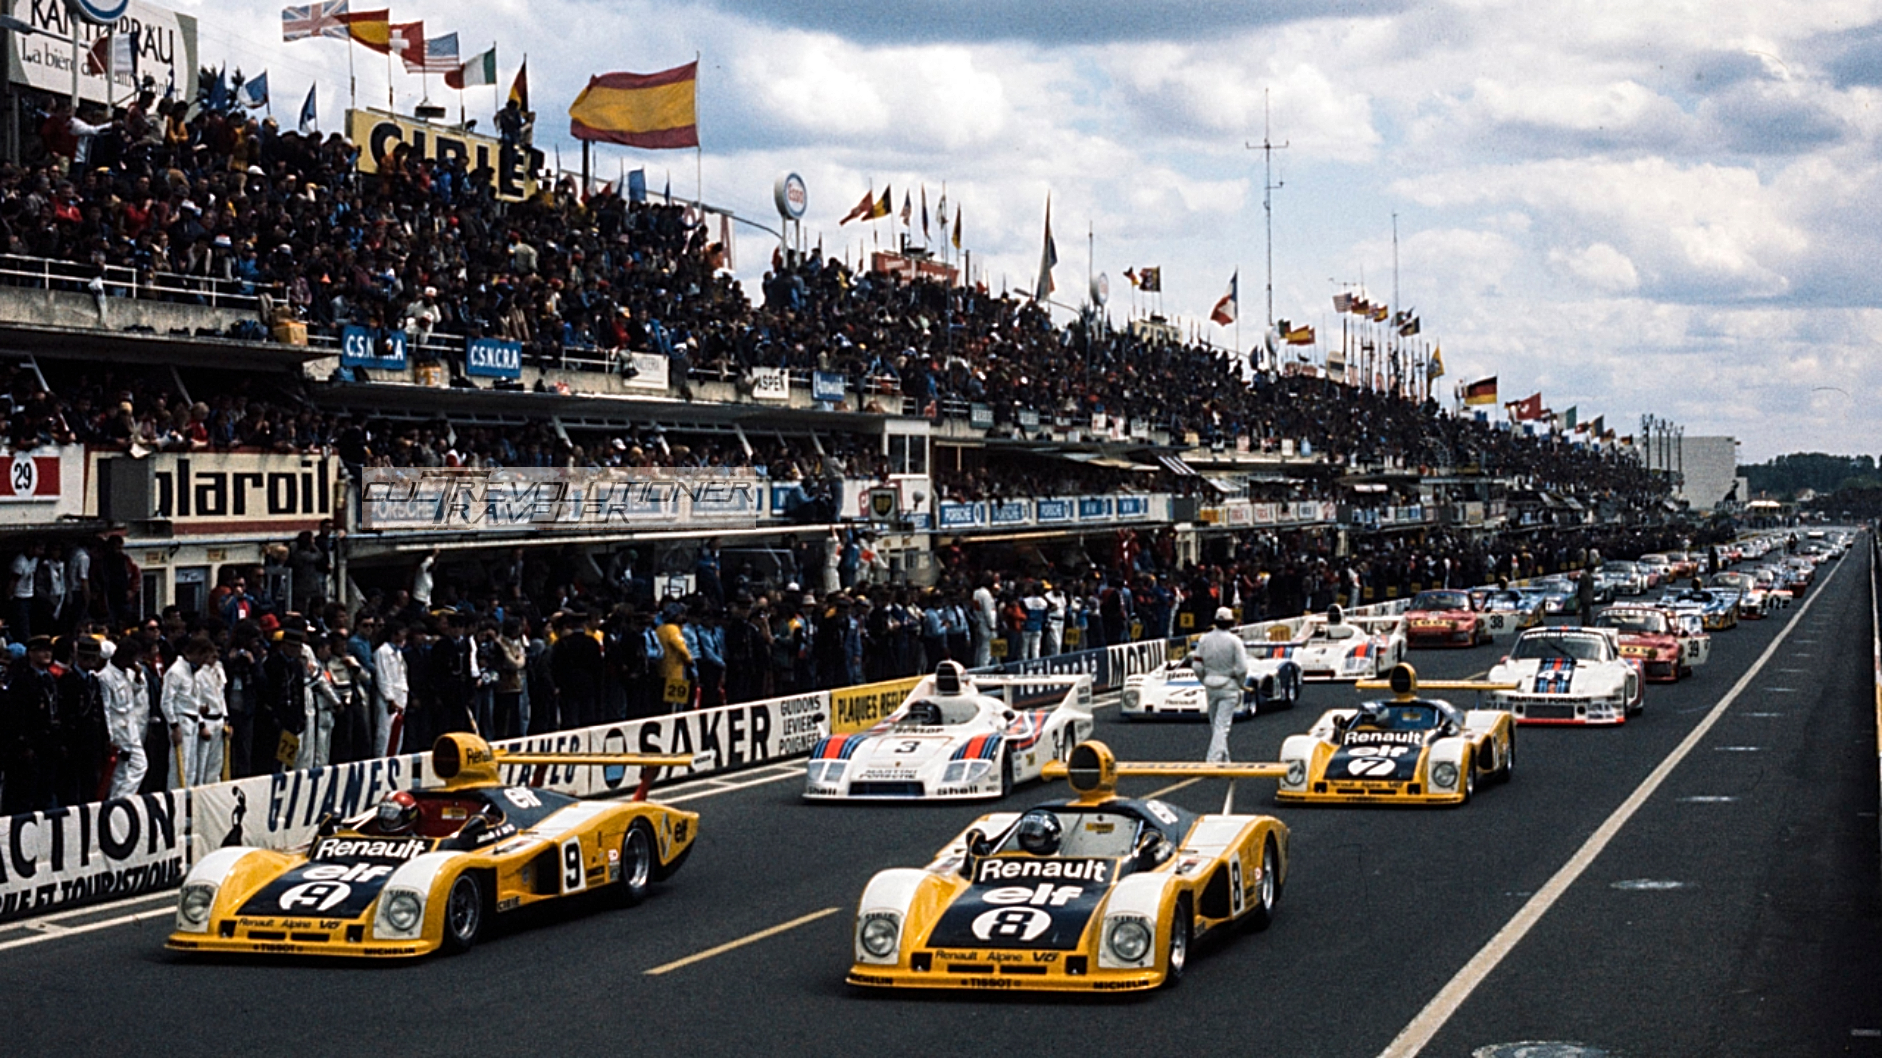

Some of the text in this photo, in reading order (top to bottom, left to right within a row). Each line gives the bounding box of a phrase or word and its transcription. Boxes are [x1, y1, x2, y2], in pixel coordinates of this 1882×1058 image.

[22, 38, 41, 63] La
[14, 462, 32, 489] 29
[1489, 614, 1504, 629] 38
[1687, 640, 1699, 658] 39
[1537, 669, 1572, 680] 41
[667, 684, 688, 698] 29
[837, 693, 878, 726] PLAQUES
[638, 704, 771, 781] SAKER
[894, 740, 922, 753] 3
[1344, 731, 1423, 746] Renault
[279, 738, 297, 760] 72
[1348, 745, 1410, 758] elf
[1355, 758, 1381, 776] 7
[268, 757, 400, 832] GITANES
[937, 785, 978, 796] Shell
[315, 838, 427, 860] Renault
[302, 863, 394, 883] elf
[565, 842, 581, 890] 9
[979, 859, 1107, 882] Renault
[982, 883, 1084, 906] elf
[1231, 861, 1242, 918] 8
[280, 919, 312, 929] Alpine
[935, 950, 978, 961] Renault
[986, 951, 1023, 962] Alpine
[970, 978, 1013, 988] TISSOT
[1093, 979, 1150, 990] MICHELIN
